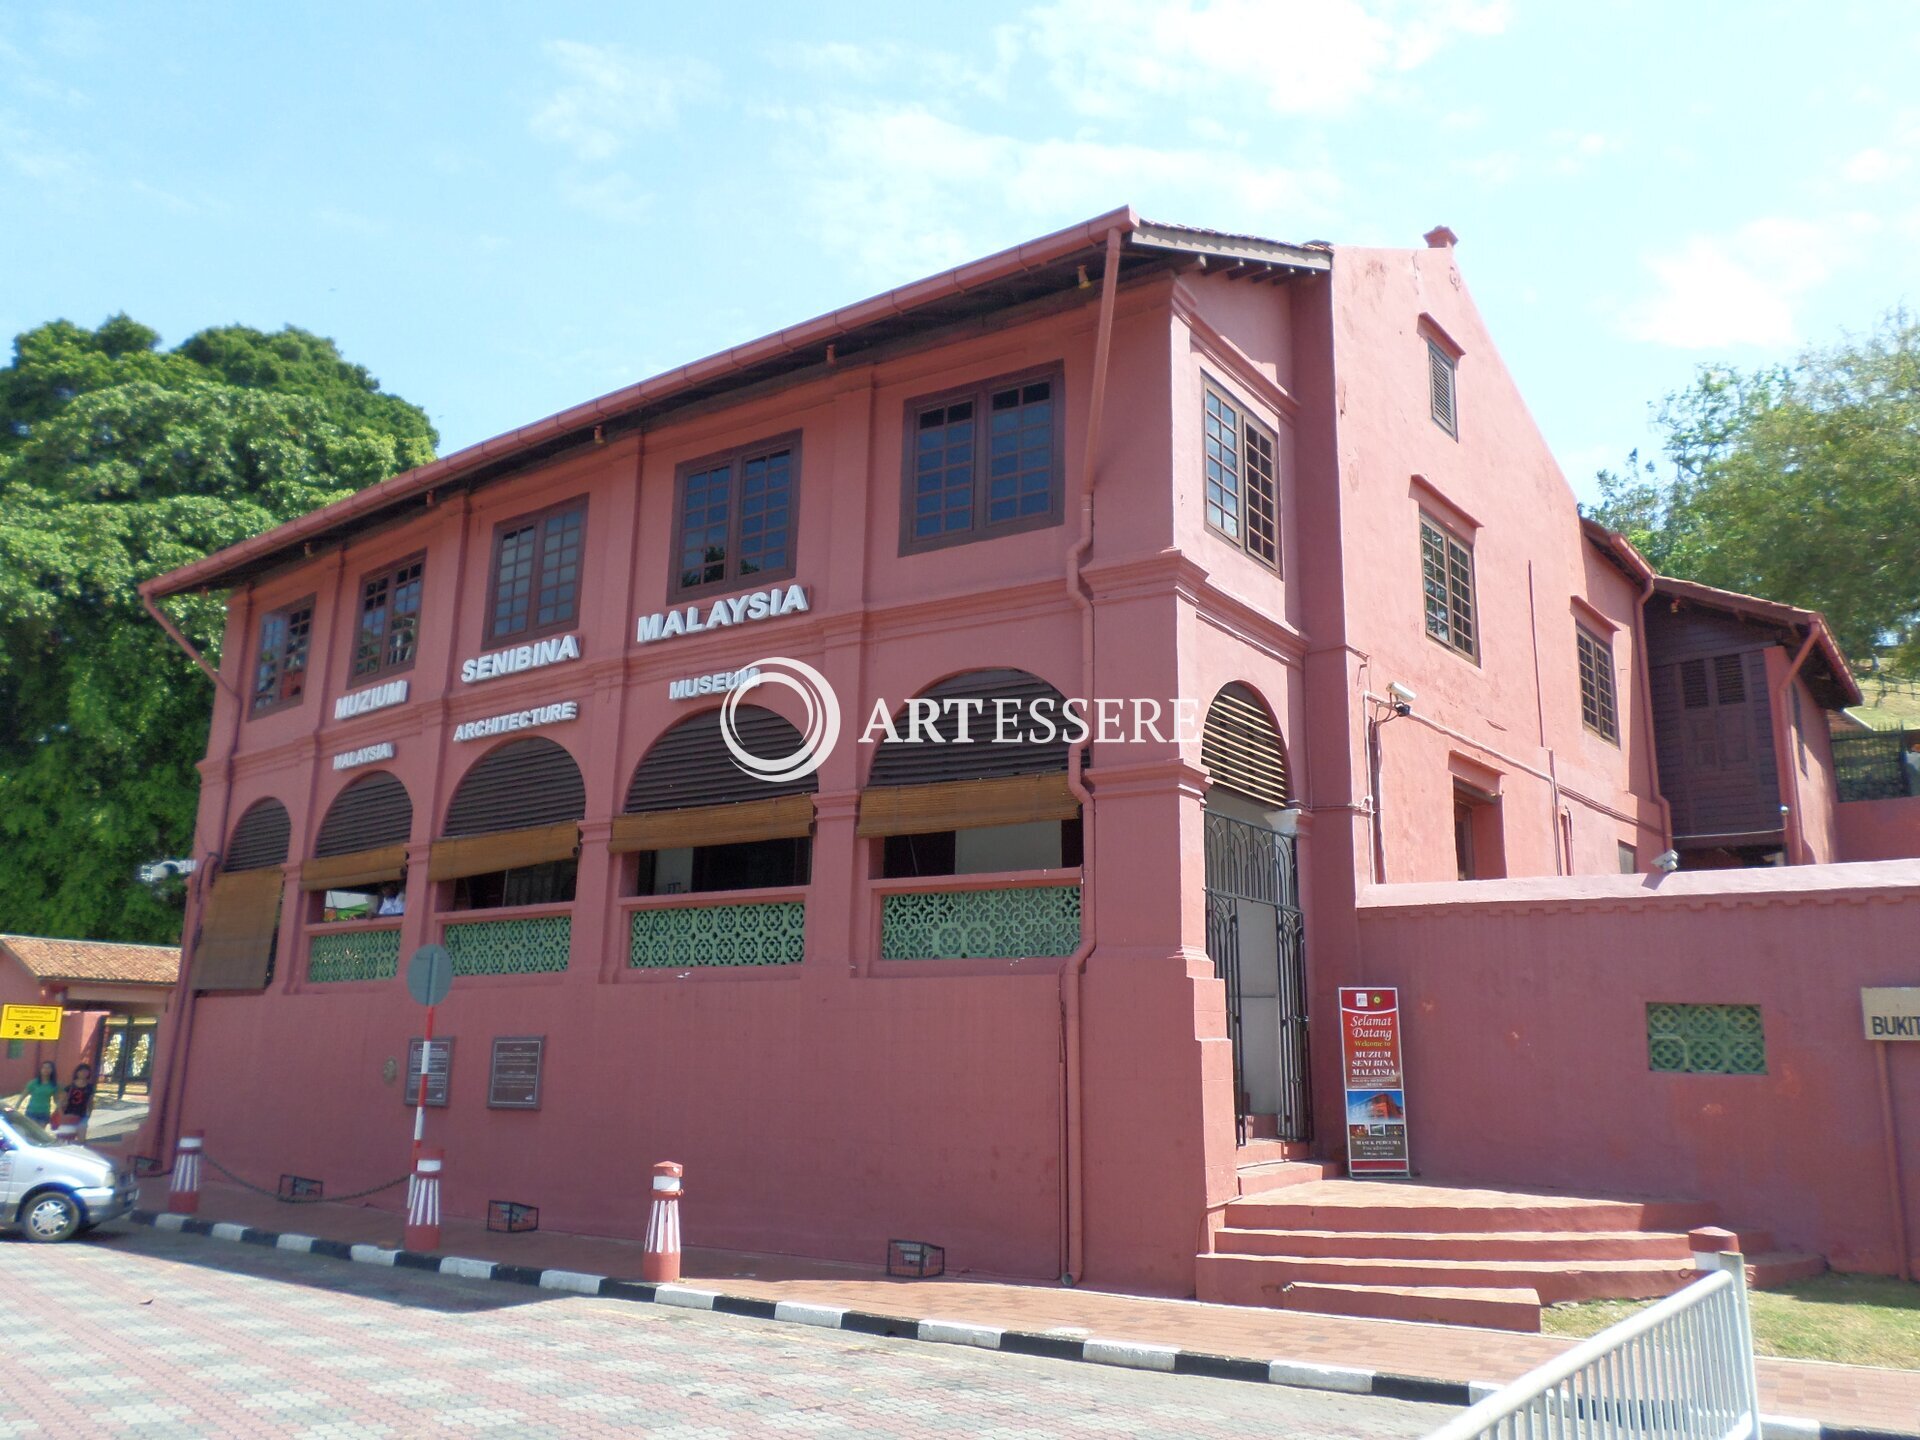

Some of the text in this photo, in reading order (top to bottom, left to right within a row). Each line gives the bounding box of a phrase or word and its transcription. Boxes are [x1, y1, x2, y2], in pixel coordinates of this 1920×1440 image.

[334, 584, 809, 720] MUZIUM SENIBINA MALAYSIA
[332, 667, 761, 771] MALAYSIA ARCHITECTURE MUSEUM
[1351, 1014, 1392, 1026] Selamat
[1871, 1015, 1920, 1036] BUKIT
[1353, 1027, 1392, 1041] Datang
